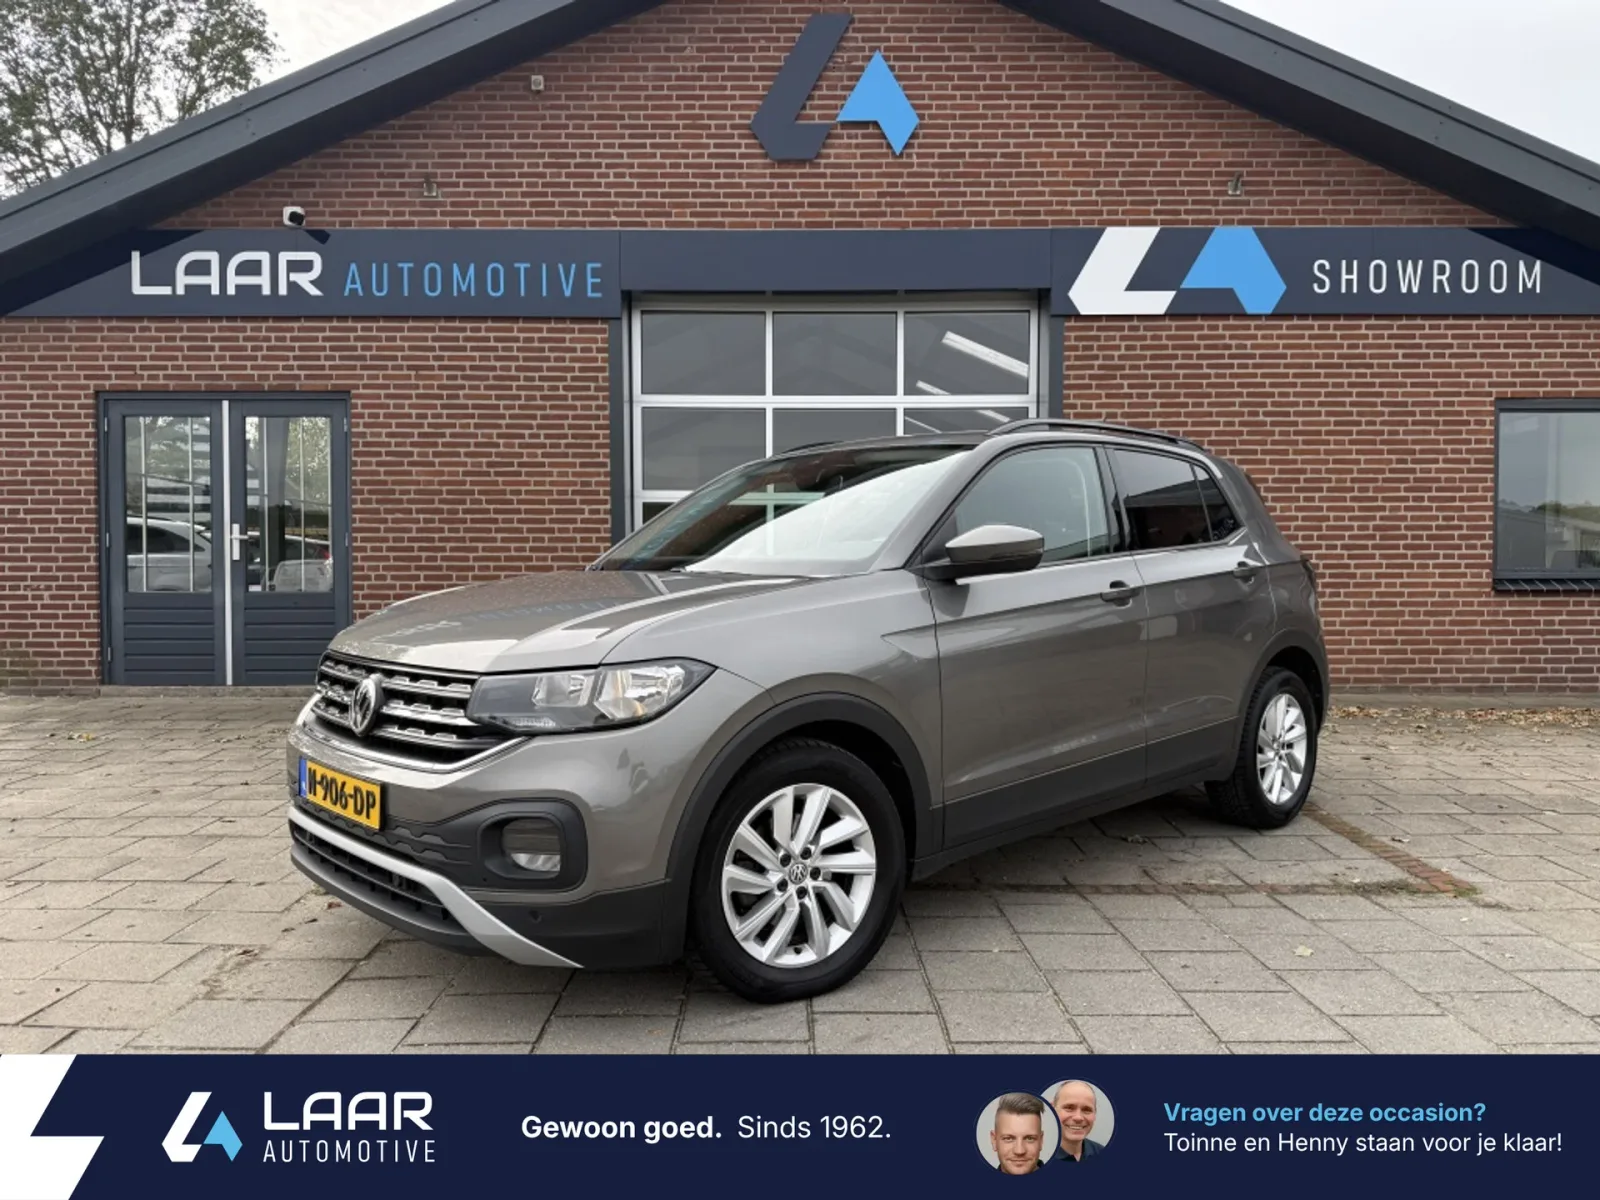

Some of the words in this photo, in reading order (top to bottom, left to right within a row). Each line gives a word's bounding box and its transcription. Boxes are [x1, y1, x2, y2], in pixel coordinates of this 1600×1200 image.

[131, 250, 324, 296] LAAR
[344, 262, 603, 298] AUTOMOTIVE
[1312, 259, 1542, 294] SHOWROOM
